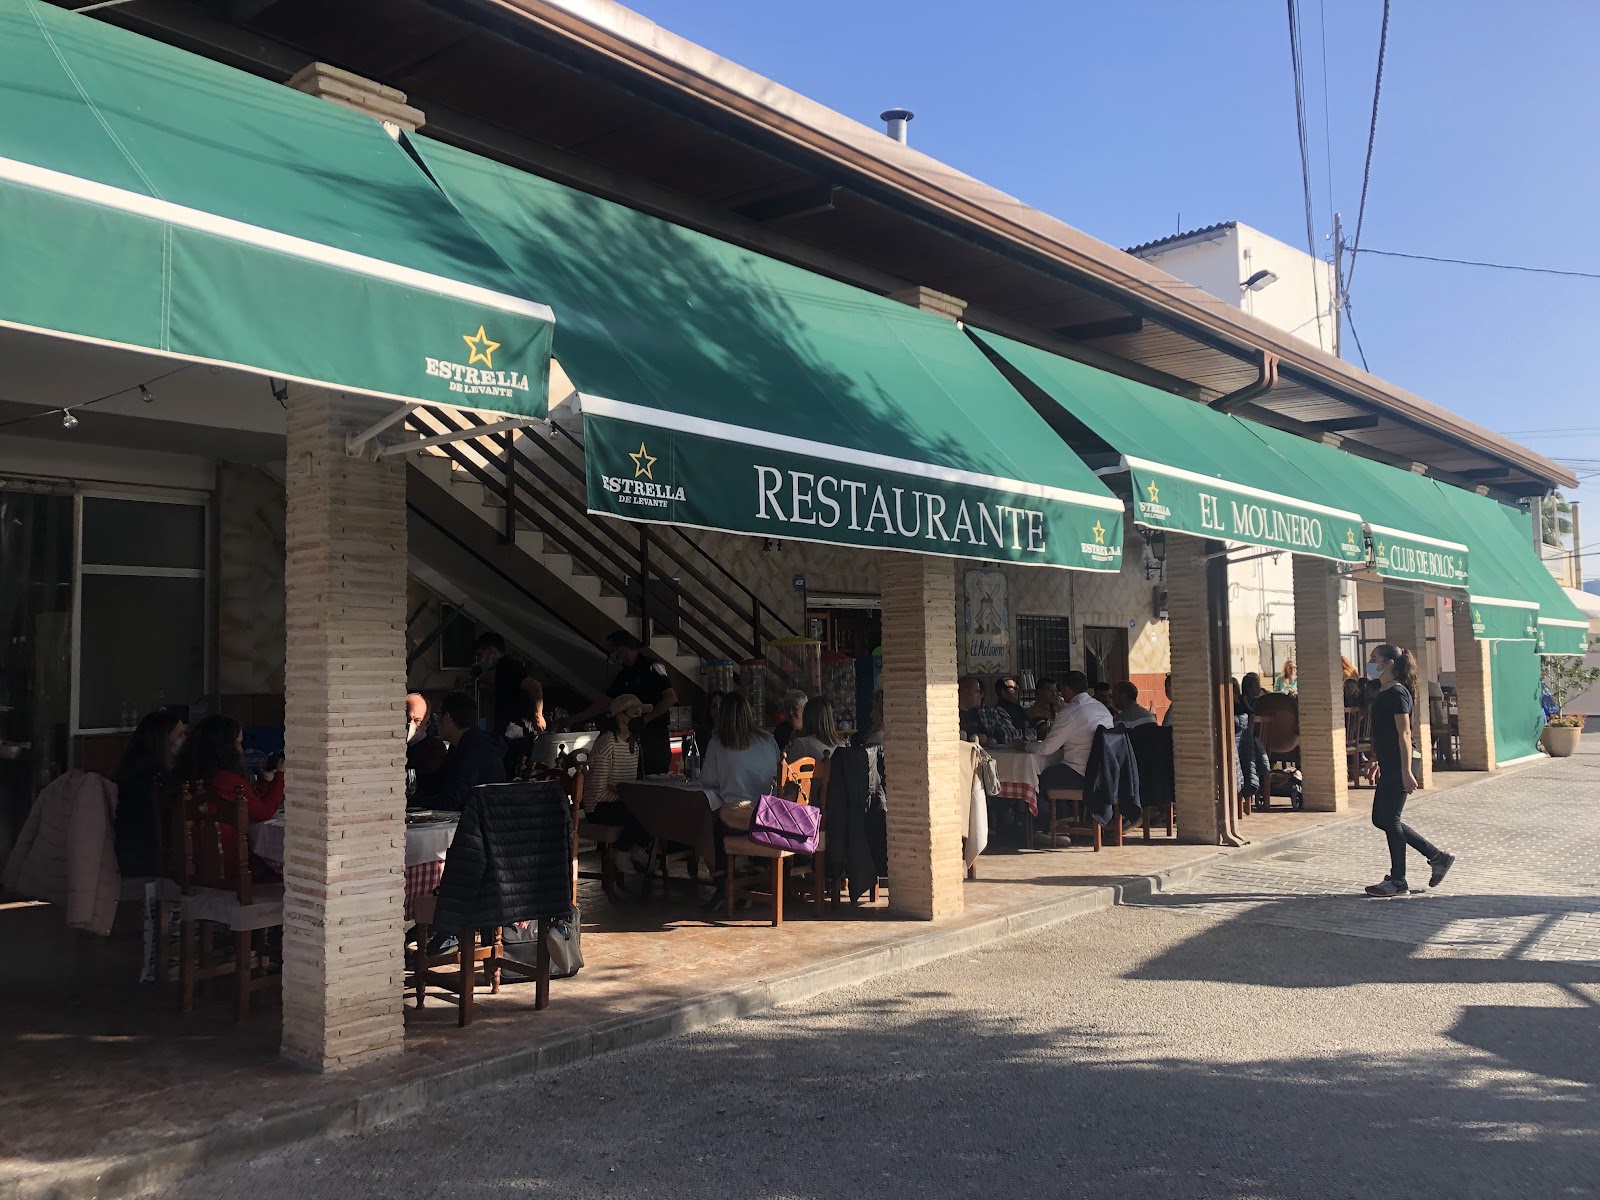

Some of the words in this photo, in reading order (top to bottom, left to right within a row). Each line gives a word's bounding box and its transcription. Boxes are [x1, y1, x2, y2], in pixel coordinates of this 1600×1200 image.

[425, 357, 529, 391] ESTRELLA
[449, 382, 463, 392] DE
[464, 385, 513, 397] LEVANTE
[601, 475, 686, 501] ESTRELLA
[618, 495, 632, 503] DE
[632, 496, 668, 508] LEVANTE
[753, 465, 1046, 552] RESTAURANTE
[1199, 493, 1225, 530] EL
[1231, 501, 1322, 548] MOLINERO
[1391, 545, 1415, 572] CLUB
[1415, 550, 1429, 574] DE
[1429, 553, 1454, 578] BOLOS
[970, 639, 978, 656] El
